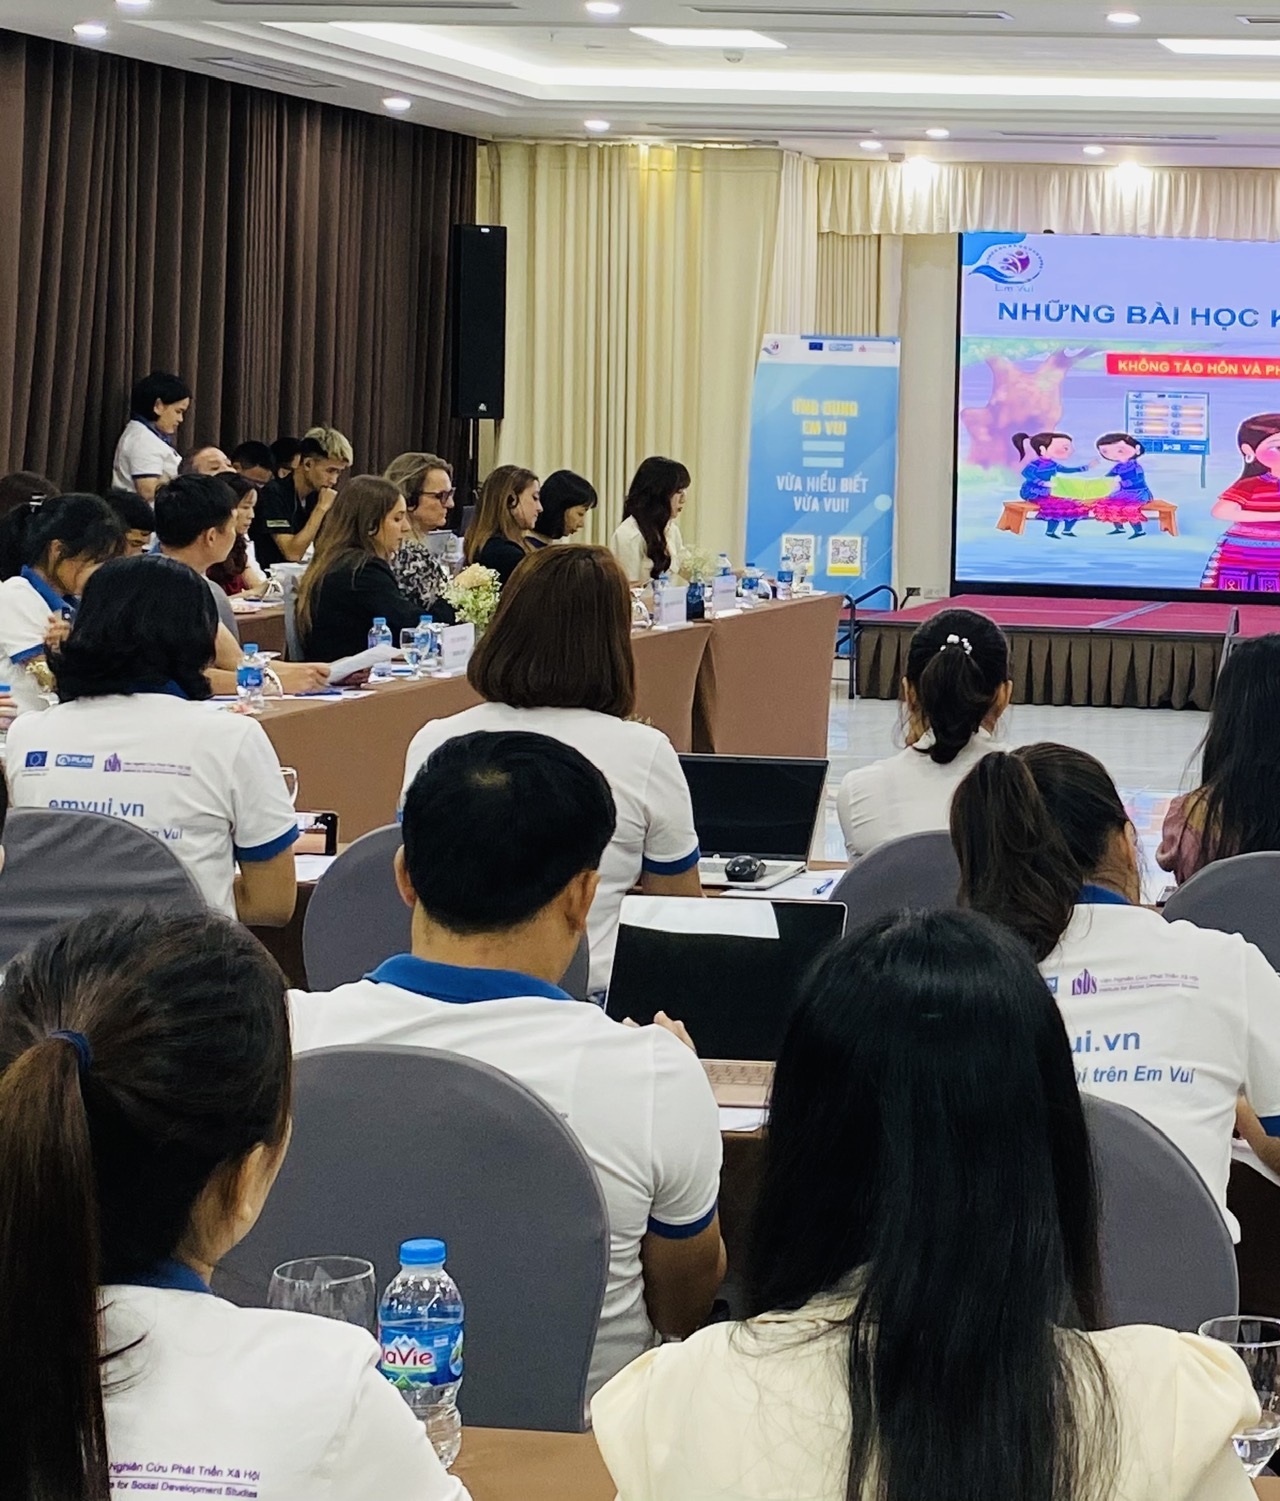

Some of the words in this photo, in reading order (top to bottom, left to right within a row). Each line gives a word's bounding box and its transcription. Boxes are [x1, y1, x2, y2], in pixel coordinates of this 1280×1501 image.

[998, 299, 1115, 324] NHỮNG
[1126, 301, 1179, 325] BÀI
[1190, 306, 1259, 331] HỌC
[1118, 357, 1170, 372] KHÔNG
[1207, 359, 1238, 375] HÔN
[1242, 360, 1262, 375] VÀ
[776, 471, 802, 491] VỪA
[806, 469, 836, 493] HIỂU
[839, 471, 869, 493] BIẾT
[823, 496, 850, 513] VUI!
[163, 828, 183, 839] Vui
[1071, 968, 1097, 996] ISDS
[1093, 1066, 1128, 1083] trên
[1134, 1065, 1162, 1082] Em
[1169, 1065, 1196, 1084] Vui
